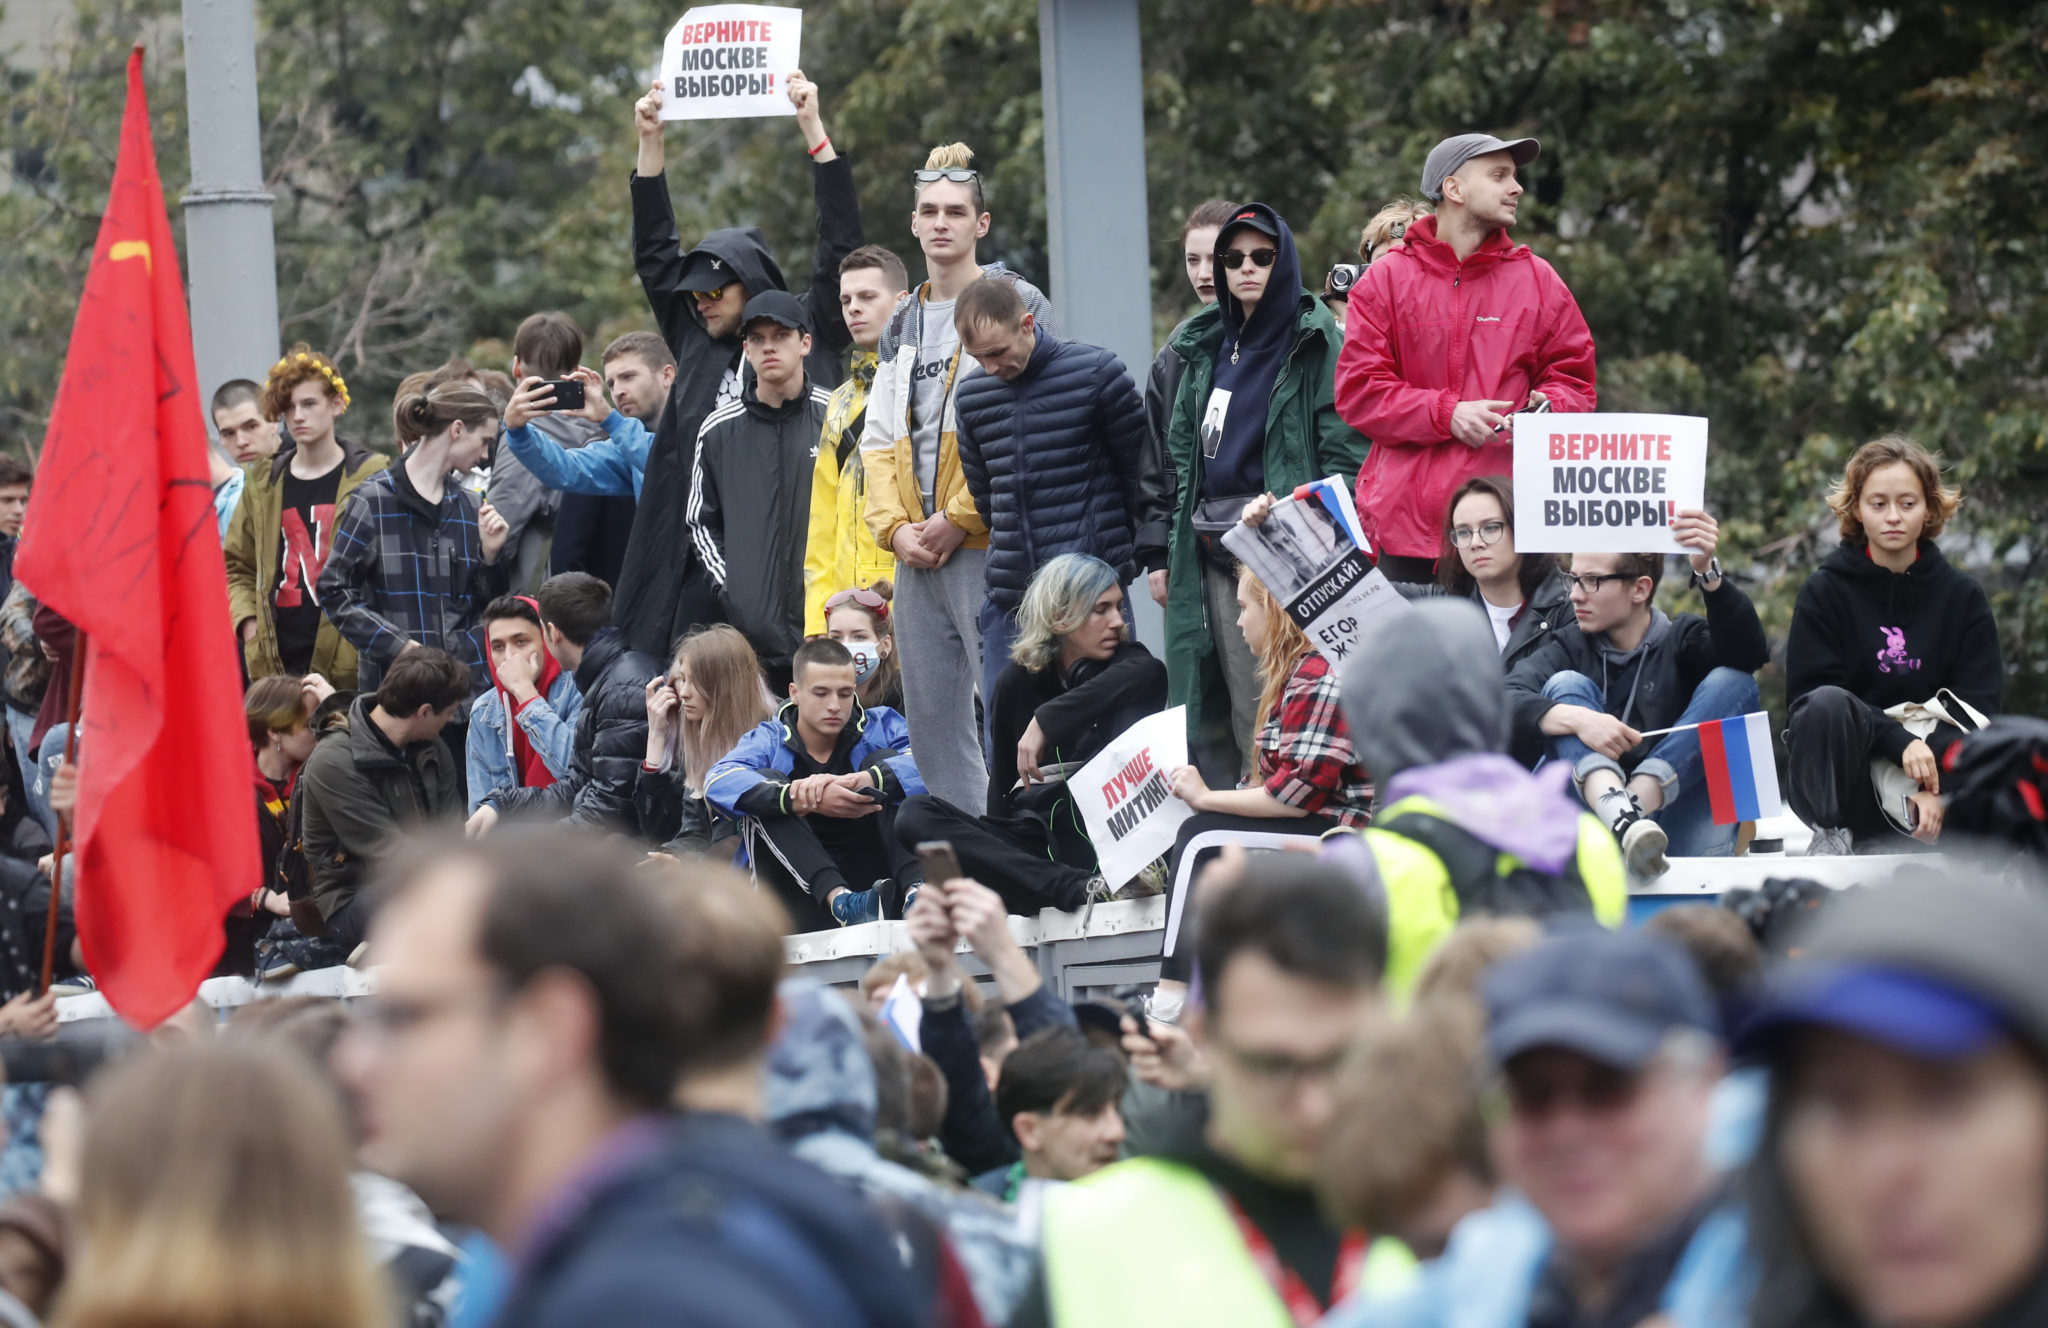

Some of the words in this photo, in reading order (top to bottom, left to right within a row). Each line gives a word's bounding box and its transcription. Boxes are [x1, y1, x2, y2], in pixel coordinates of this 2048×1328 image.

[681, 20, 772, 45] ВЕРНИТЕ
[681, 46, 768, 71] МОСКВЕ
[674, 73, 775, 98] ВЫБОРЫ!
[1548, 433, 1672, 461] ВЕРНИТЕ
[1553, 466, 1667, 494] МОСКВЕ
[1543, 499, 1676, 527] ВЫБОРЫ!
[1297, 559, 1363, 619] ОТПУСКАЙ!
[1318, 616, 1358, 644] ЕГОР
[1101, 746, 1154, 810] ЛУЧШЕ
[1106, 768, 1173, 842] МИТИНГ!
